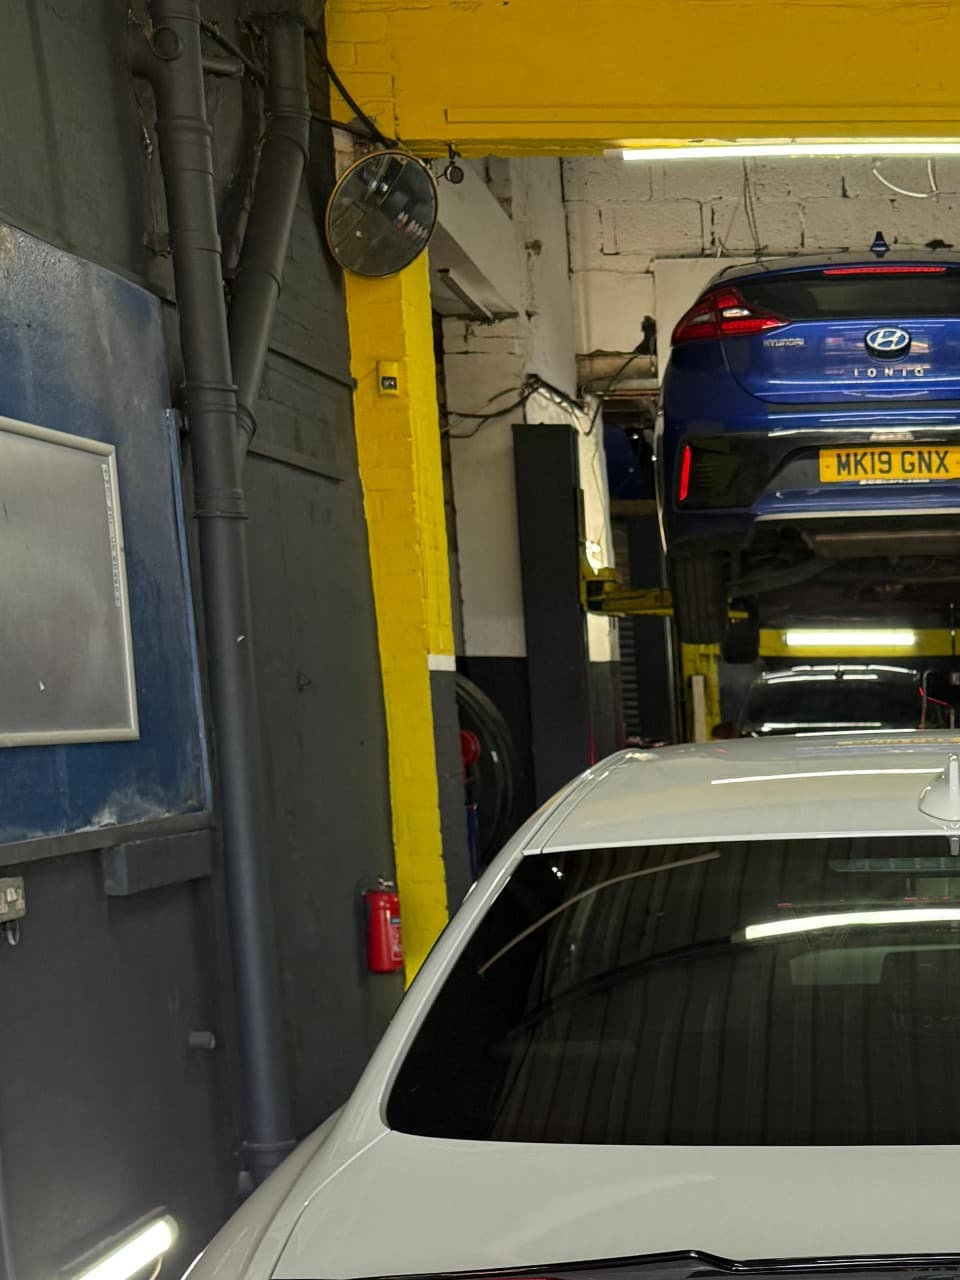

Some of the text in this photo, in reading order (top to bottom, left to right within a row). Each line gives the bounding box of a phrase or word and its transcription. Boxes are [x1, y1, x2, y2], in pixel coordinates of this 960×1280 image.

[763, 338, 804, 347] HYUNDAI
[854, 367, 925, 378] IONIQ
[836, 450, 949, 476] MK19 GNX
